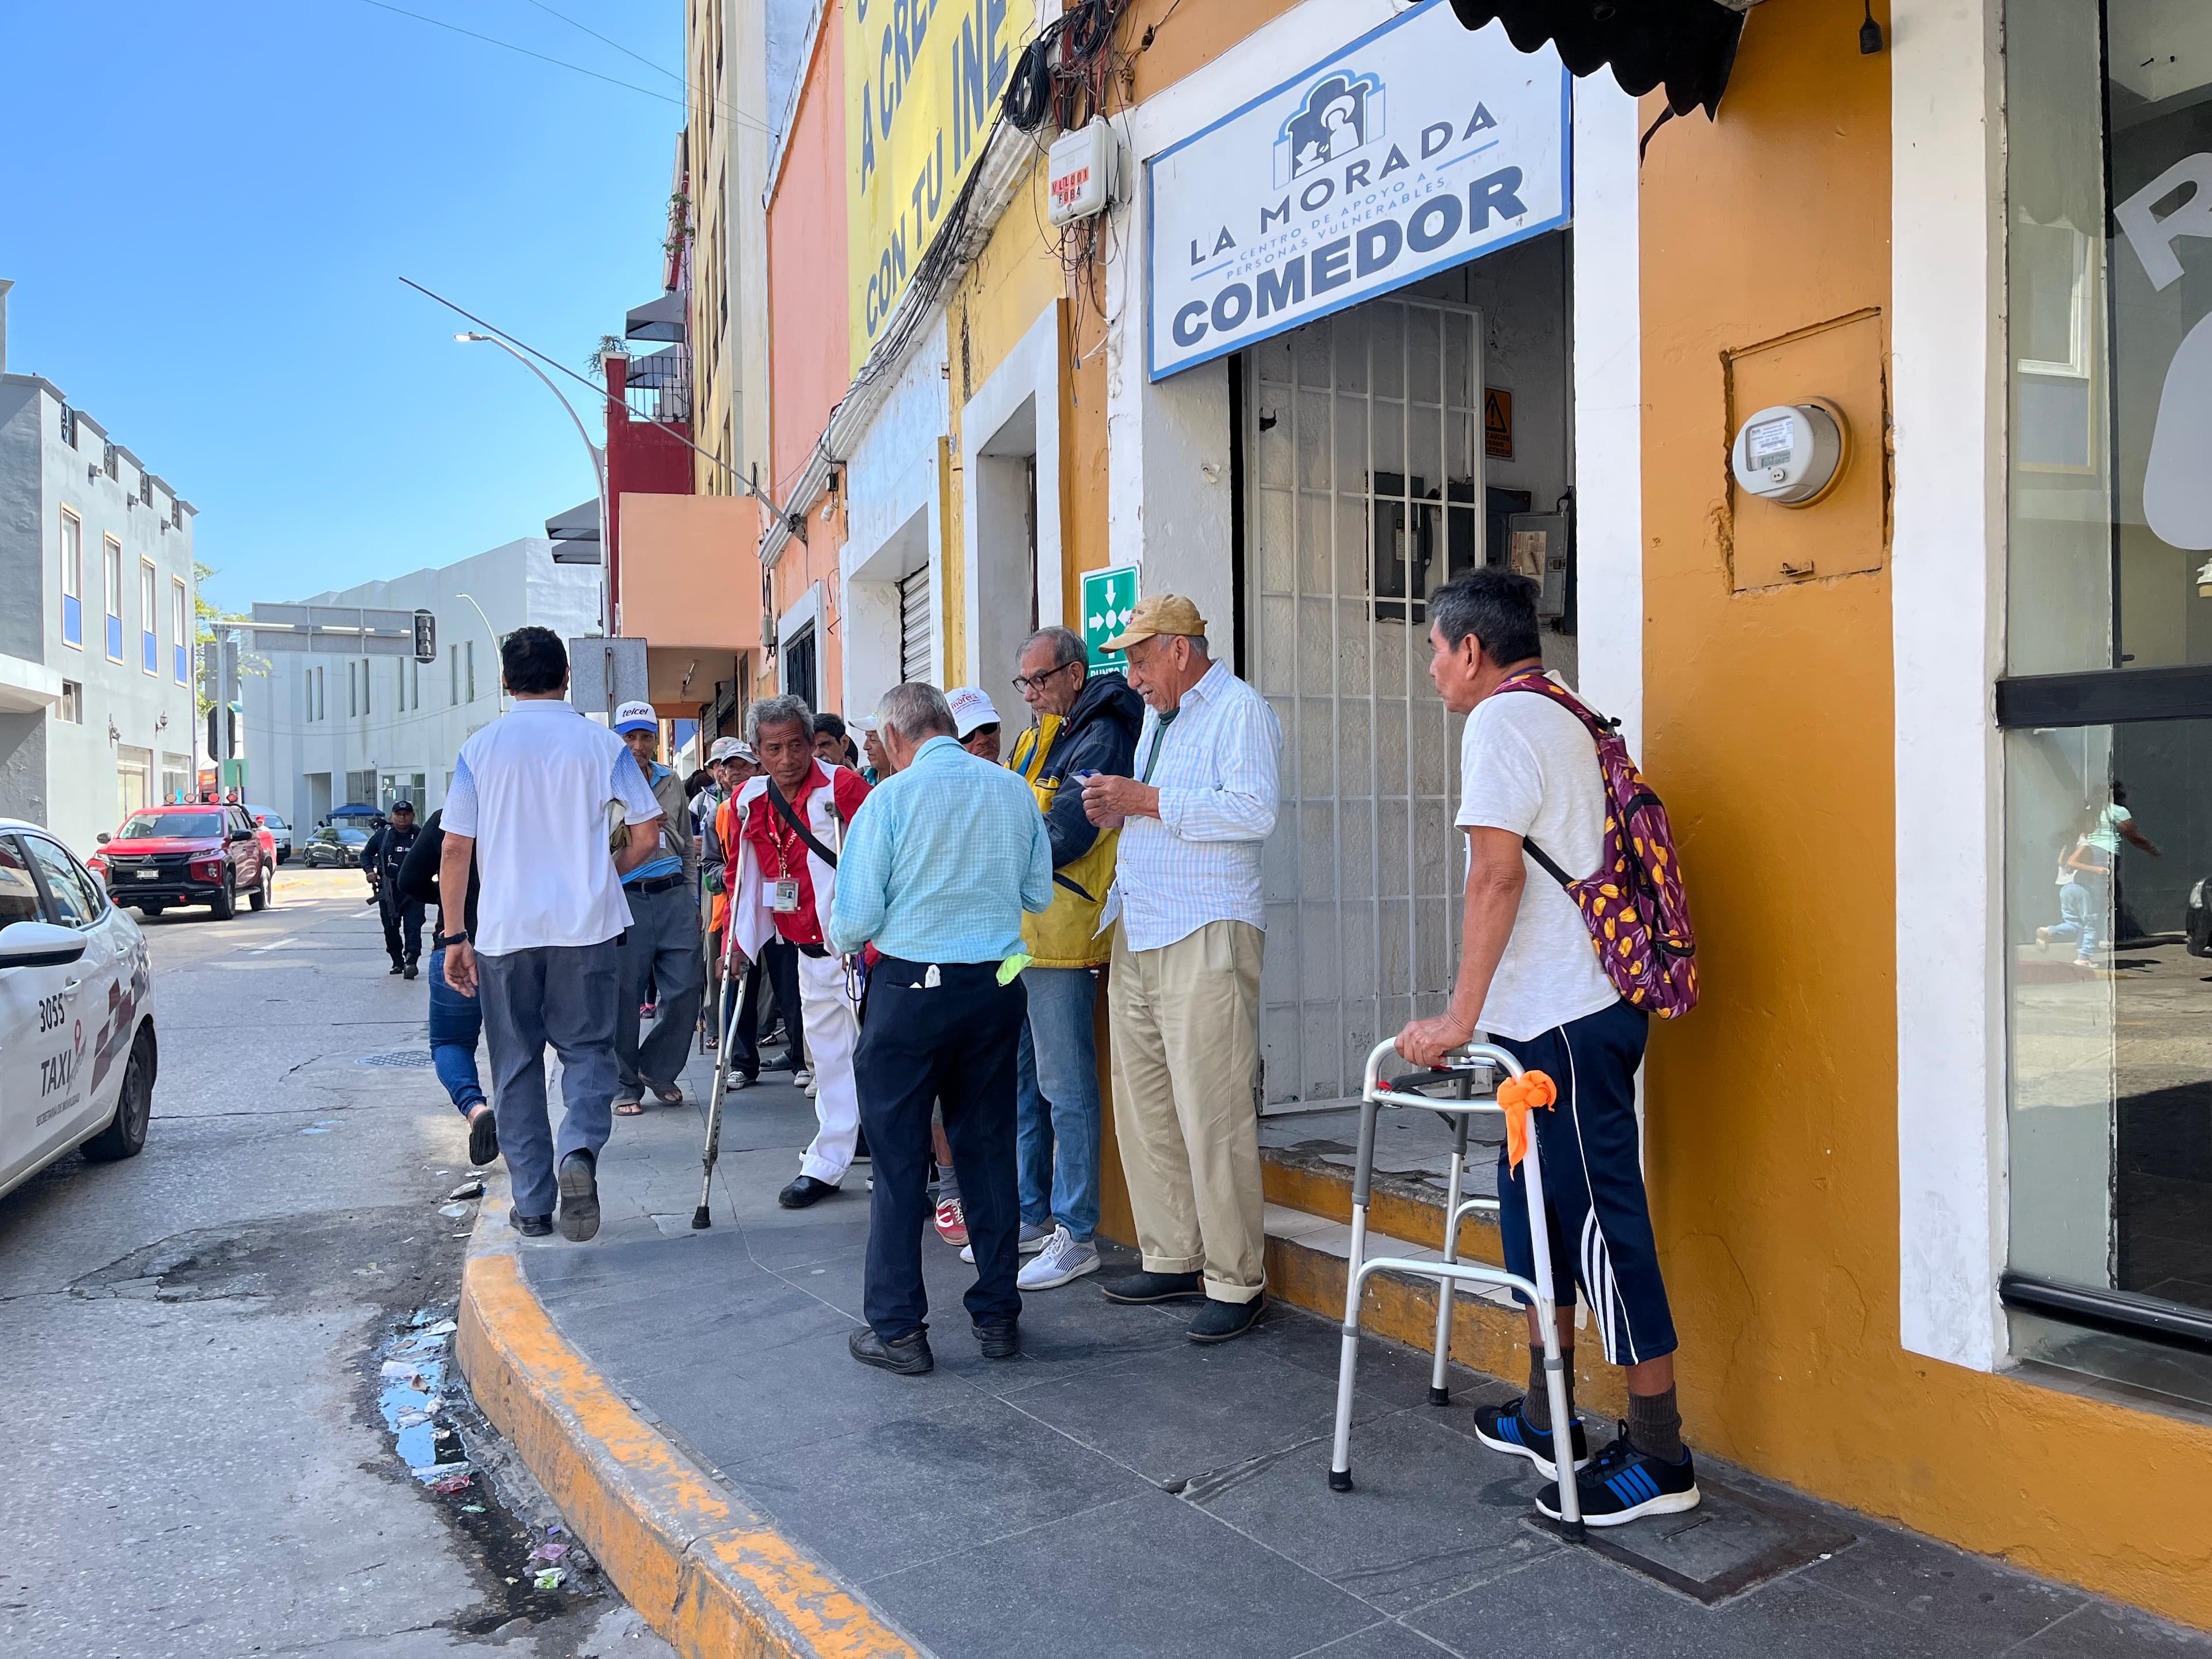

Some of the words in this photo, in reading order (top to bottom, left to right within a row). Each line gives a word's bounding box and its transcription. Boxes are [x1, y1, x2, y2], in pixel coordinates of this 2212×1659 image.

[862, 78, 875, 197] A
[880, 0, 938, 141] CRE
[867, 211, 906, 338] CON
[912, 127, 942, 251] TU
[952, 0, 1008, 178] INE
[1191, 225, 1237, 266] LA
[1260, 101, 1498, 234] MORADA
[1240, 228, 1301, 260] CENTRO
[1312, 214, 1331, 229] DE
[1341, 181, 1405, 217] APOYO
[1417, 172, 1426, 183] A
[1172, 166, 1528, 347] COMEDOR
[1227, 239, 1308, 280] PERSONAS
[1318, 177, 1445, 240] VULNERABLES
[622, 707, 649, 717] telcel
[38, 993, 65, 1033] 3055
[41, 1049, 71, 1097] TAXI
